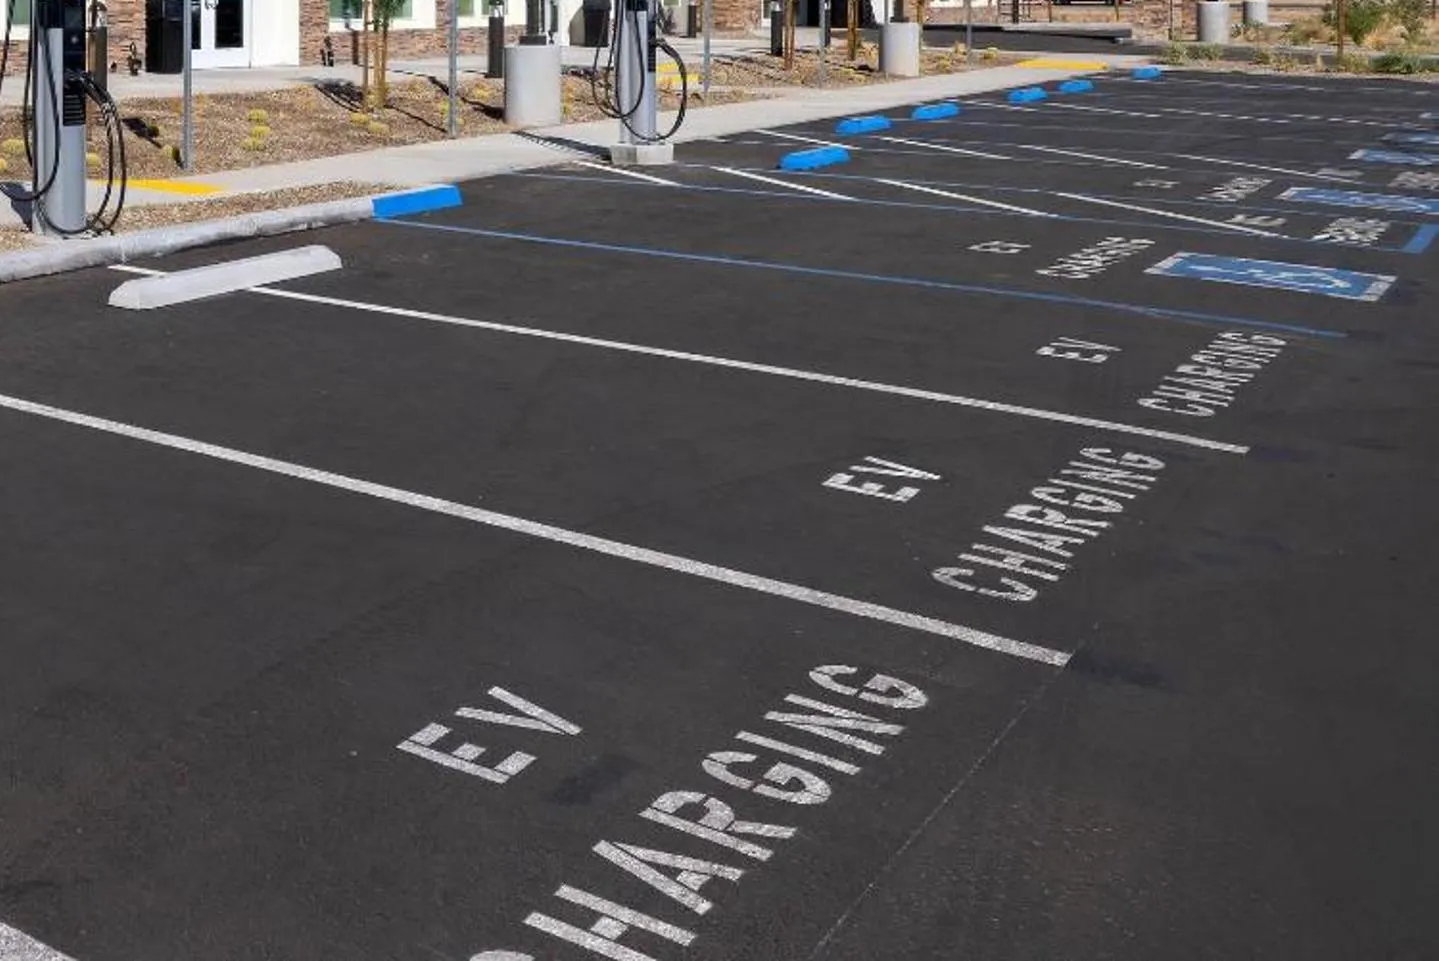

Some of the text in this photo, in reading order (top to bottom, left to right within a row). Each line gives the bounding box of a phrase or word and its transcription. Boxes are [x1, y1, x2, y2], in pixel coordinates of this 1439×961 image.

[821, 454, 942, 503] EV
[932, 447, 1166, 602] CHARGING
[398, 685, 583, 785] EV
[468, 663, 929, 961] HARGING
